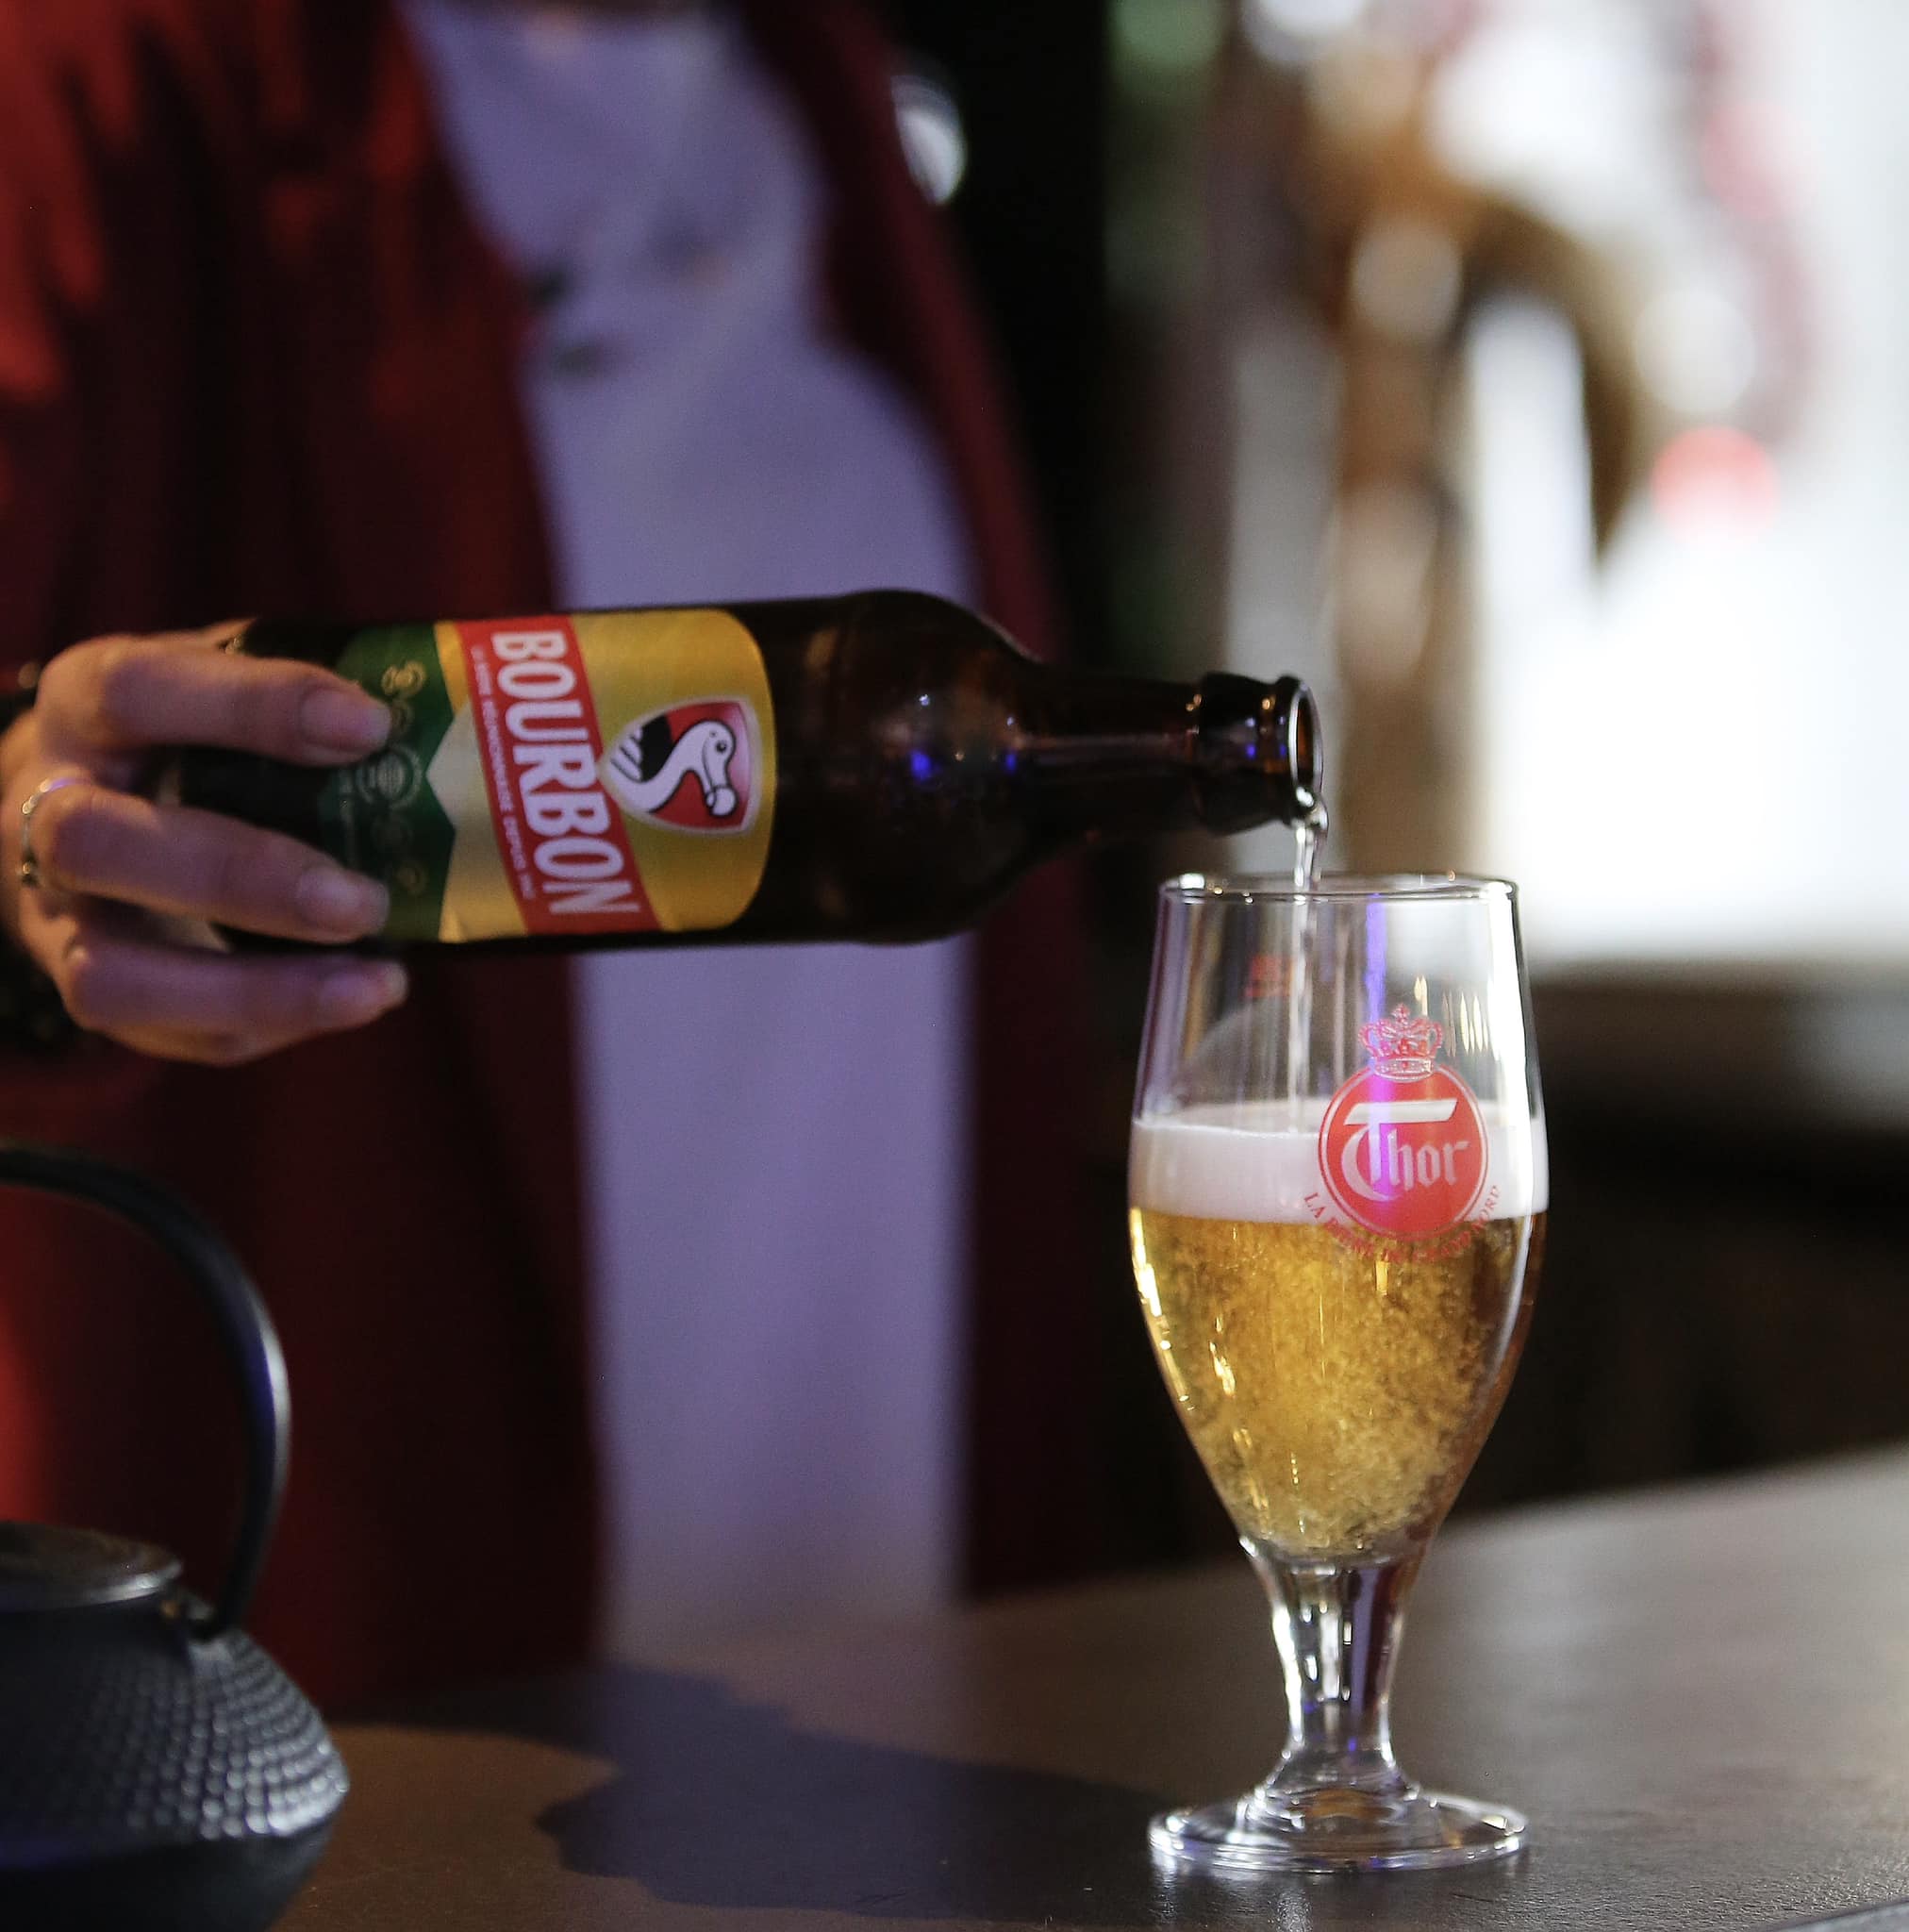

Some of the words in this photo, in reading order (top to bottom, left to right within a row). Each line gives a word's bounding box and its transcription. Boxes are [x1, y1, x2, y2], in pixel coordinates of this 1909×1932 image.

[491, 630, 640, 914] BOURBON
[1341, 1098, 1471, 1203] Thor
[1303, 1191, 1327, 1219] LA
